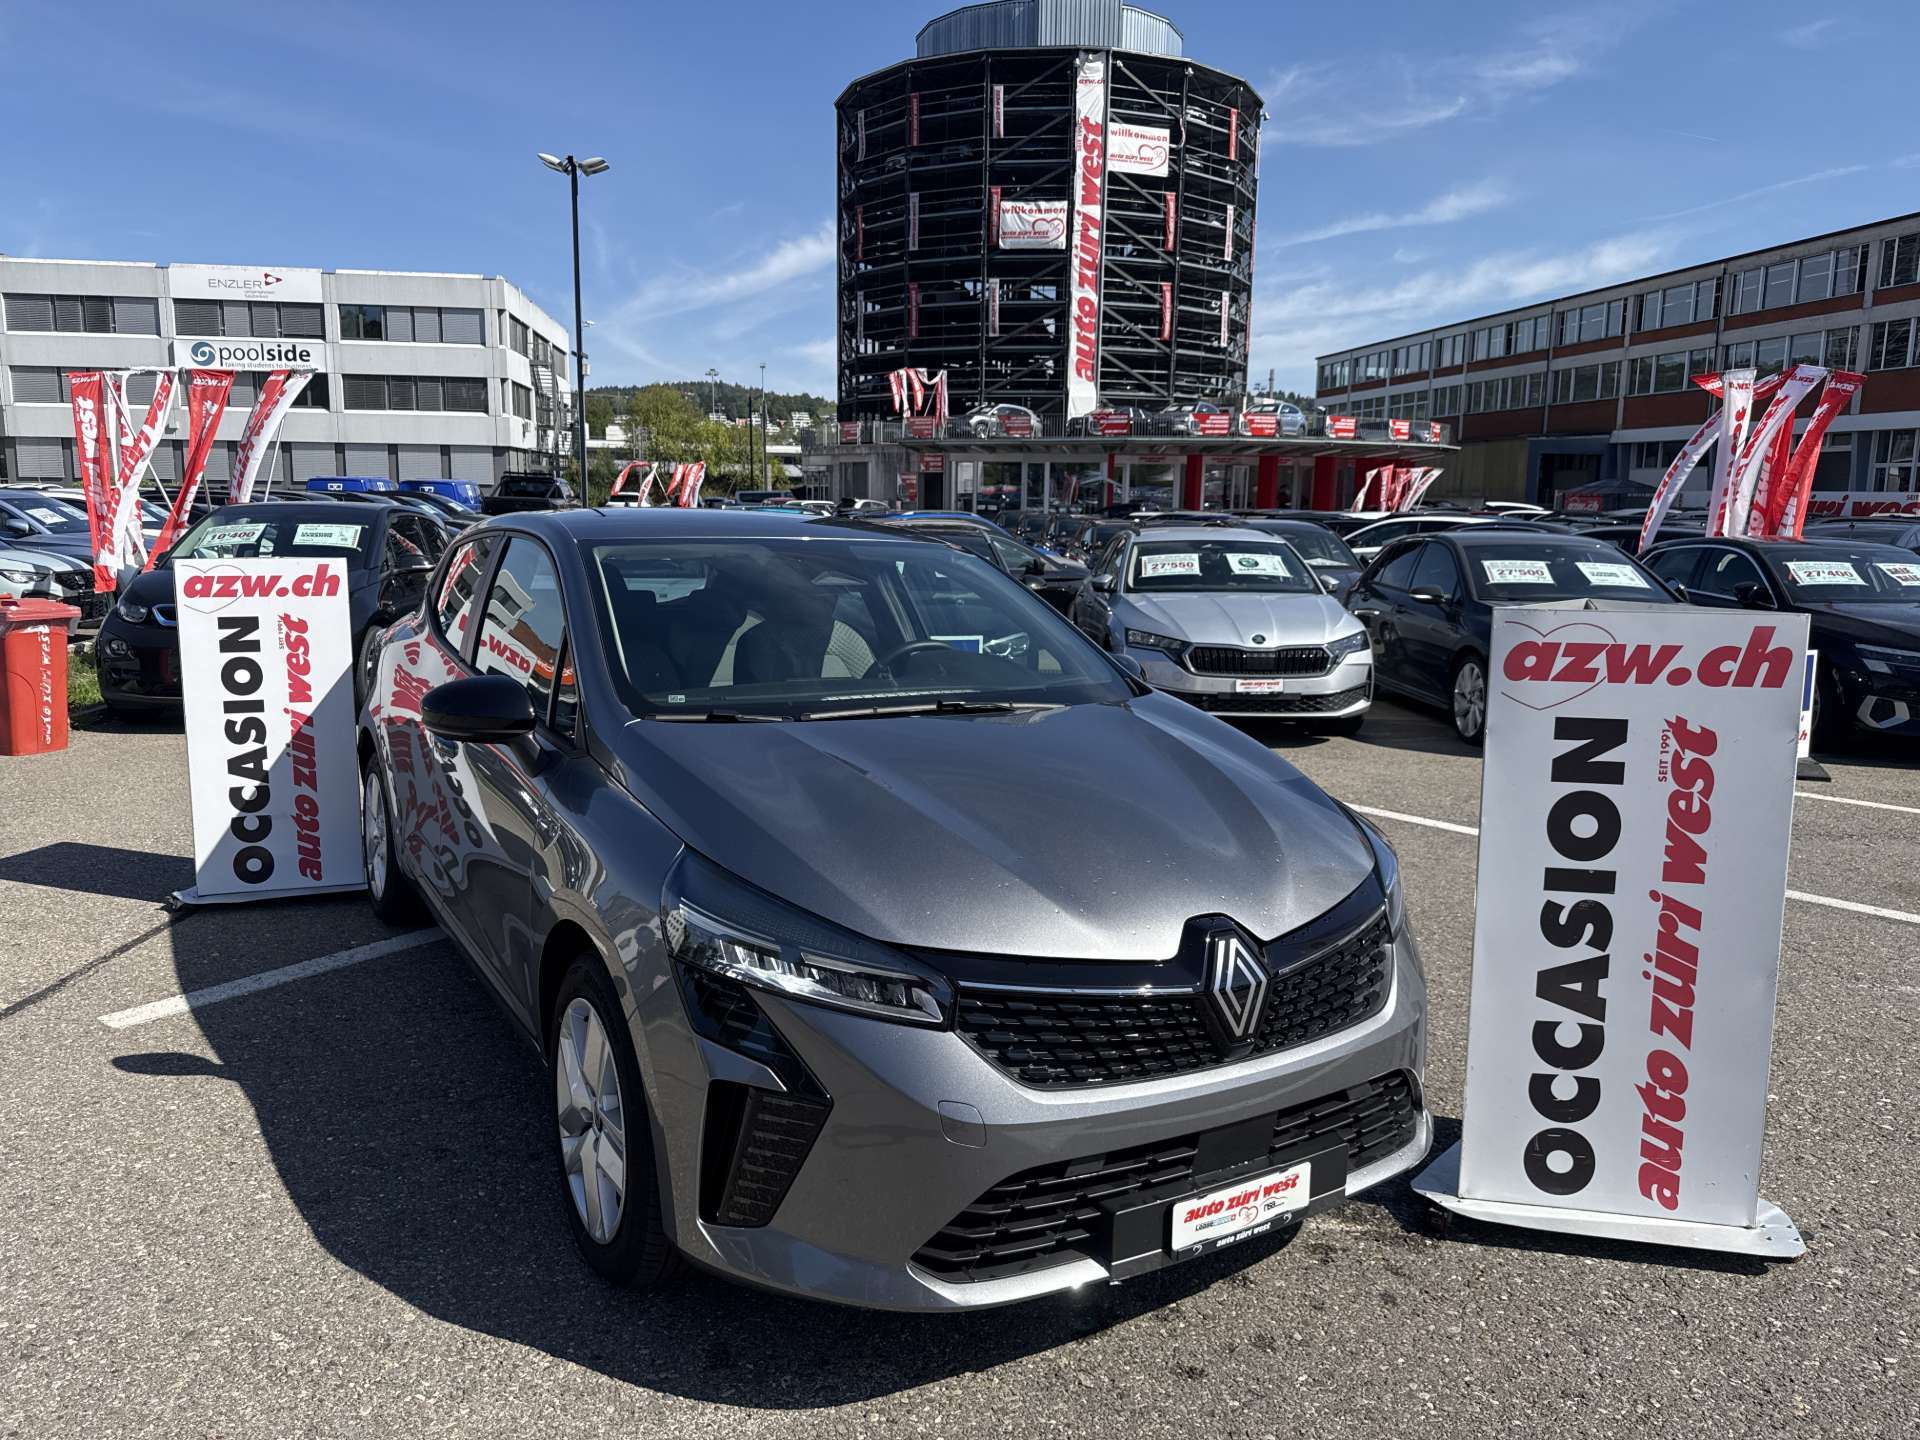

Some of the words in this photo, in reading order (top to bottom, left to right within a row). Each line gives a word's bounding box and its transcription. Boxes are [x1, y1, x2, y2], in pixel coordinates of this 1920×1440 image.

[1081, 115, 1104, 205] west
[1110, 128, 1168, 142] willkommen
[1002, 205, 1066, 215] willkommen
[1073, 209, 1101, 290] züri
[208, 278, 262, 289] ENZLER
[219, 343, 311, 367] poolside
[1074, 296, 1098, 382] auto
[76, 396, 98, 459] west
[210, 531, 255, 541] 10'400
[183, 564, 341, 599] azw.ch
[1151, 562, 1194, 570] 27'550
[1497, 568, 1545, 577] 27'500
[1803, 570, 1853, 578] 27'400
[279, 612, 313, 703] west
[1503, 626, 1793, 689] azw.ch
[40, 707, 52, 745] auto
[217, 616, 275, 884] OCCASION
[283, 707, 317, 793] züri
[1659, 728, 1671, 754] 1991
[1657, 755, 1669, 783] SEIT
[1662, 714, 1718, 885] west
[290, 794, 323, 882] auto
[1523, 716, 1629, 1196] OCCASION
[1642, 889, 1704, 1052] züri
[1634, 1048, 1692, 1212] auto
[1184, 1199, 1225, 1224] auto
[1225, 1185, 1262, 1211] züri
[1263, 1173, 1299, 1198] west
[1216, 1235, 1235, 1247] auto
[1236, 1228, 1253, 1241] züri
[1253, 1222, 1271, 1235] west
